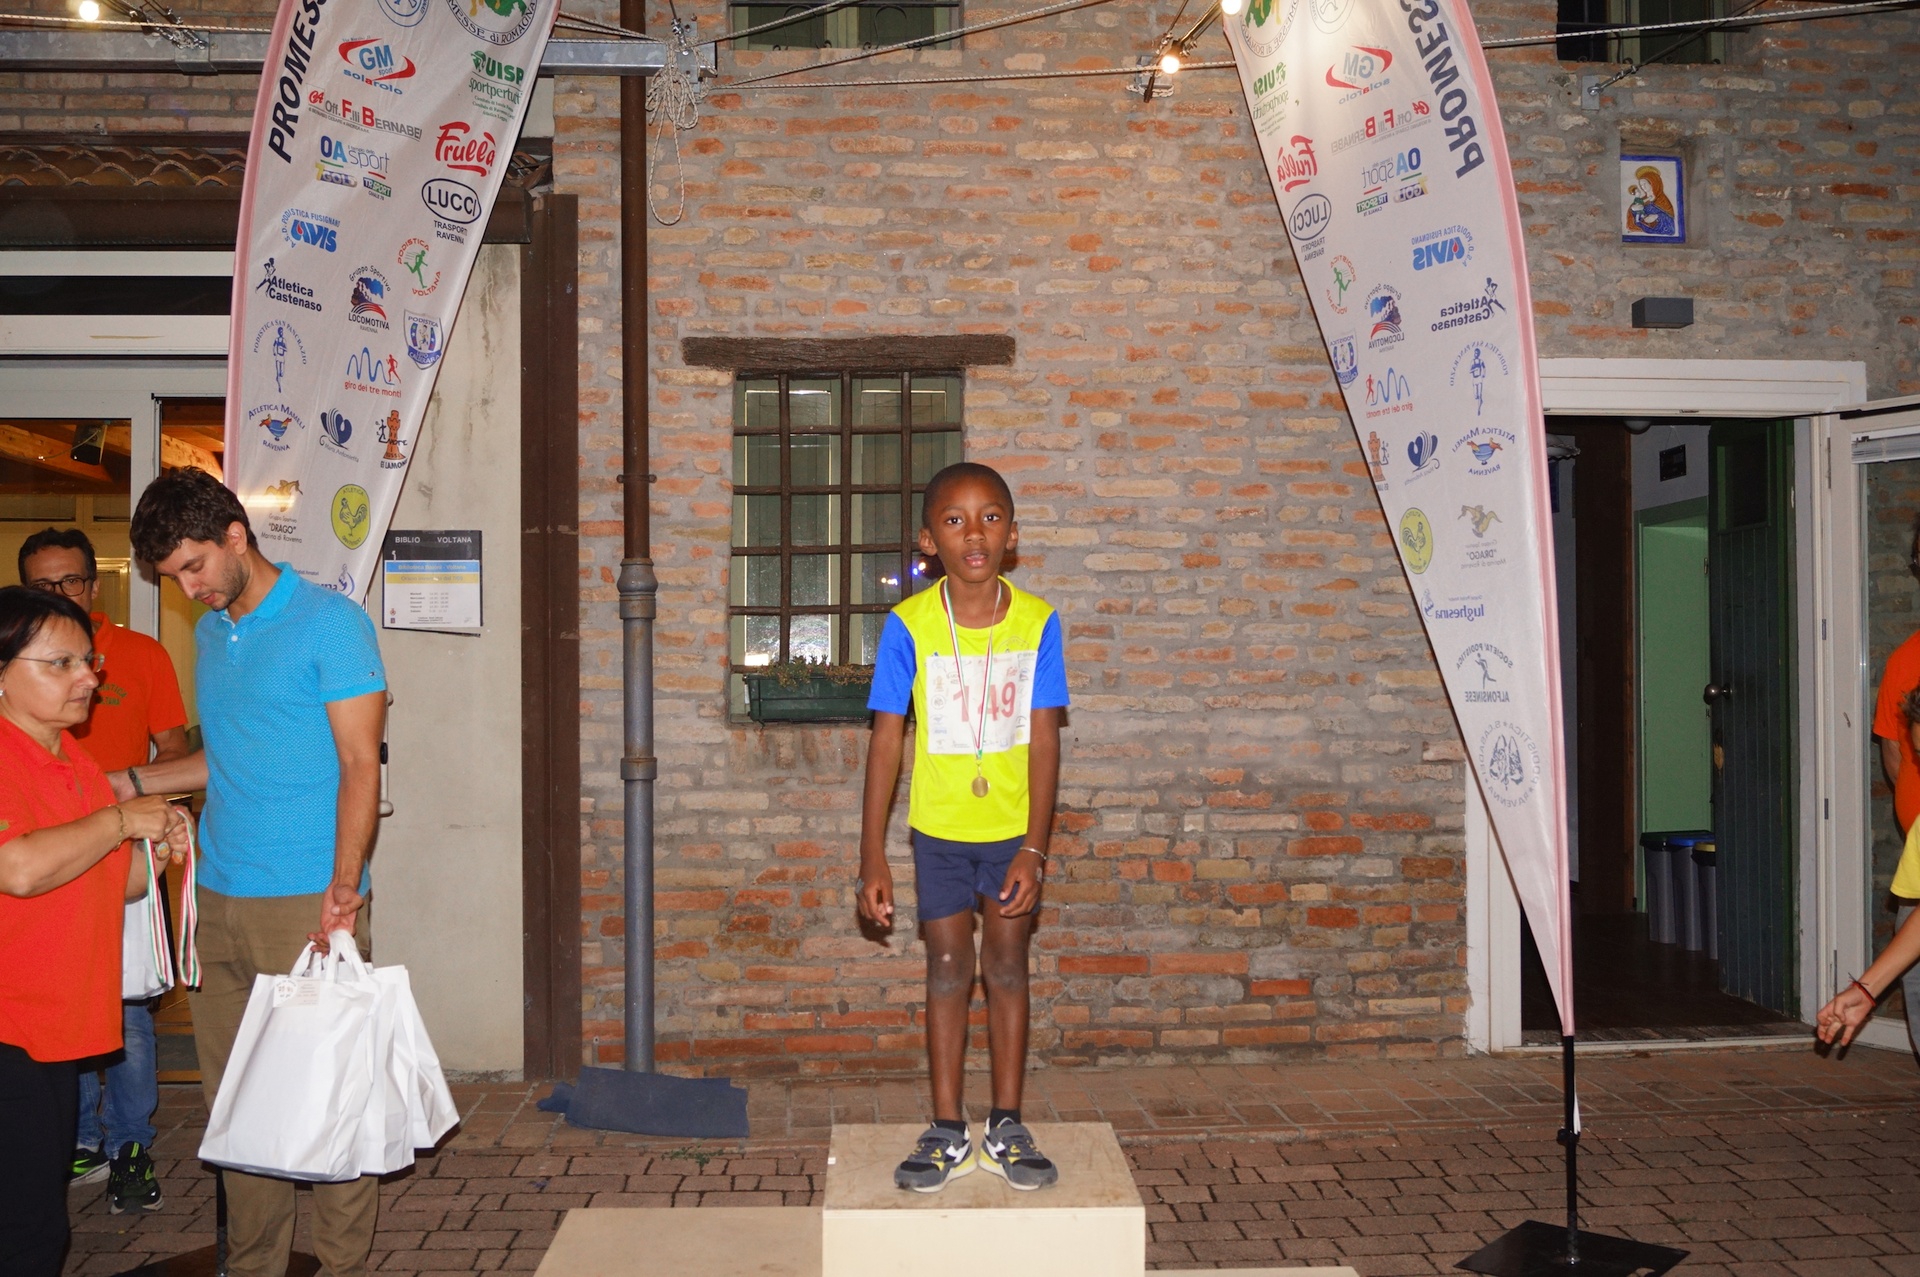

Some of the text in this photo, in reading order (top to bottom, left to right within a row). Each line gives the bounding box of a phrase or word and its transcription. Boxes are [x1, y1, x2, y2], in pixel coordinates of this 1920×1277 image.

[448, 0, 536, 43] MESSE di ROMAGNA
[358, 45, 394, 71] GM
[485, 58, 525, 85] UISP
[268, 0, 327, 163] PROMES
[343, 69, 403, 95] solarolo
[378, 68, 393, 76] sport
[362, 106, 423, 139] BERNABEI
[434, 121, 496, 167] Frullà
[349, 150, 390, 173] sport
[428, 186, 477, 217] LUCCI
[291, 219, 337, 253] AVIS
[436, 231, 465, 245] RAVENNA
[397, 237, 430, 265] PODISTICA
[271, 276, 314, 298] Atletica
[349, 265, 391, 292] Gruppo Sportivo
[412, 270, 442, 297] VOLTANA
[269, 287, 323, 313] Castenaso
[348, 313, 390, 331] LOCOMOTIVA
[344, 381, 357, 391] giro
[369, 385, 380, 395] tre
[381, 388, 402, 399] monti
[262, 439, 291, 452] RAVENNA
[953, 681, 1016, 722] 149
